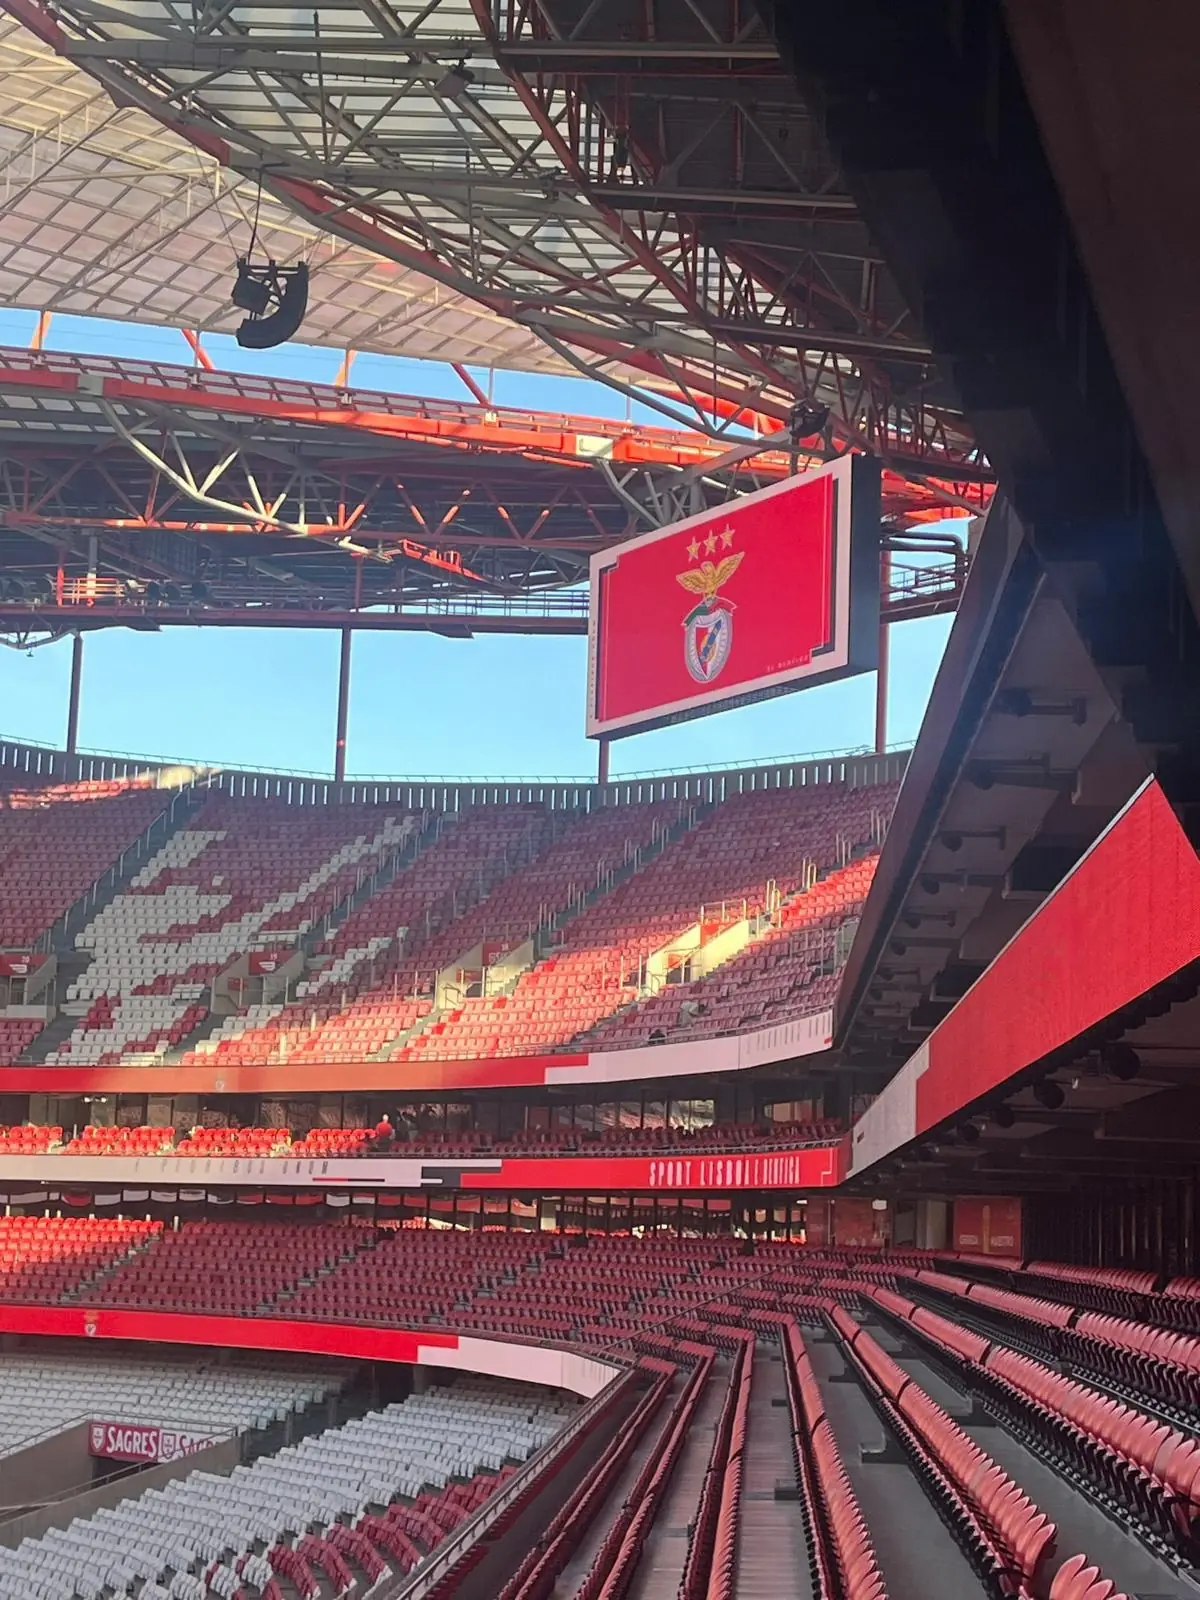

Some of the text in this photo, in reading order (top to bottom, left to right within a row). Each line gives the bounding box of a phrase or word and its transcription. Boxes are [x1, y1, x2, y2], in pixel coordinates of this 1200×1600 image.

[649, 1160, 691, 1186] SPORT
[701, 1159, 749, 1186] LISBOA
[106, 1426, 157, 1458] SAGRES
